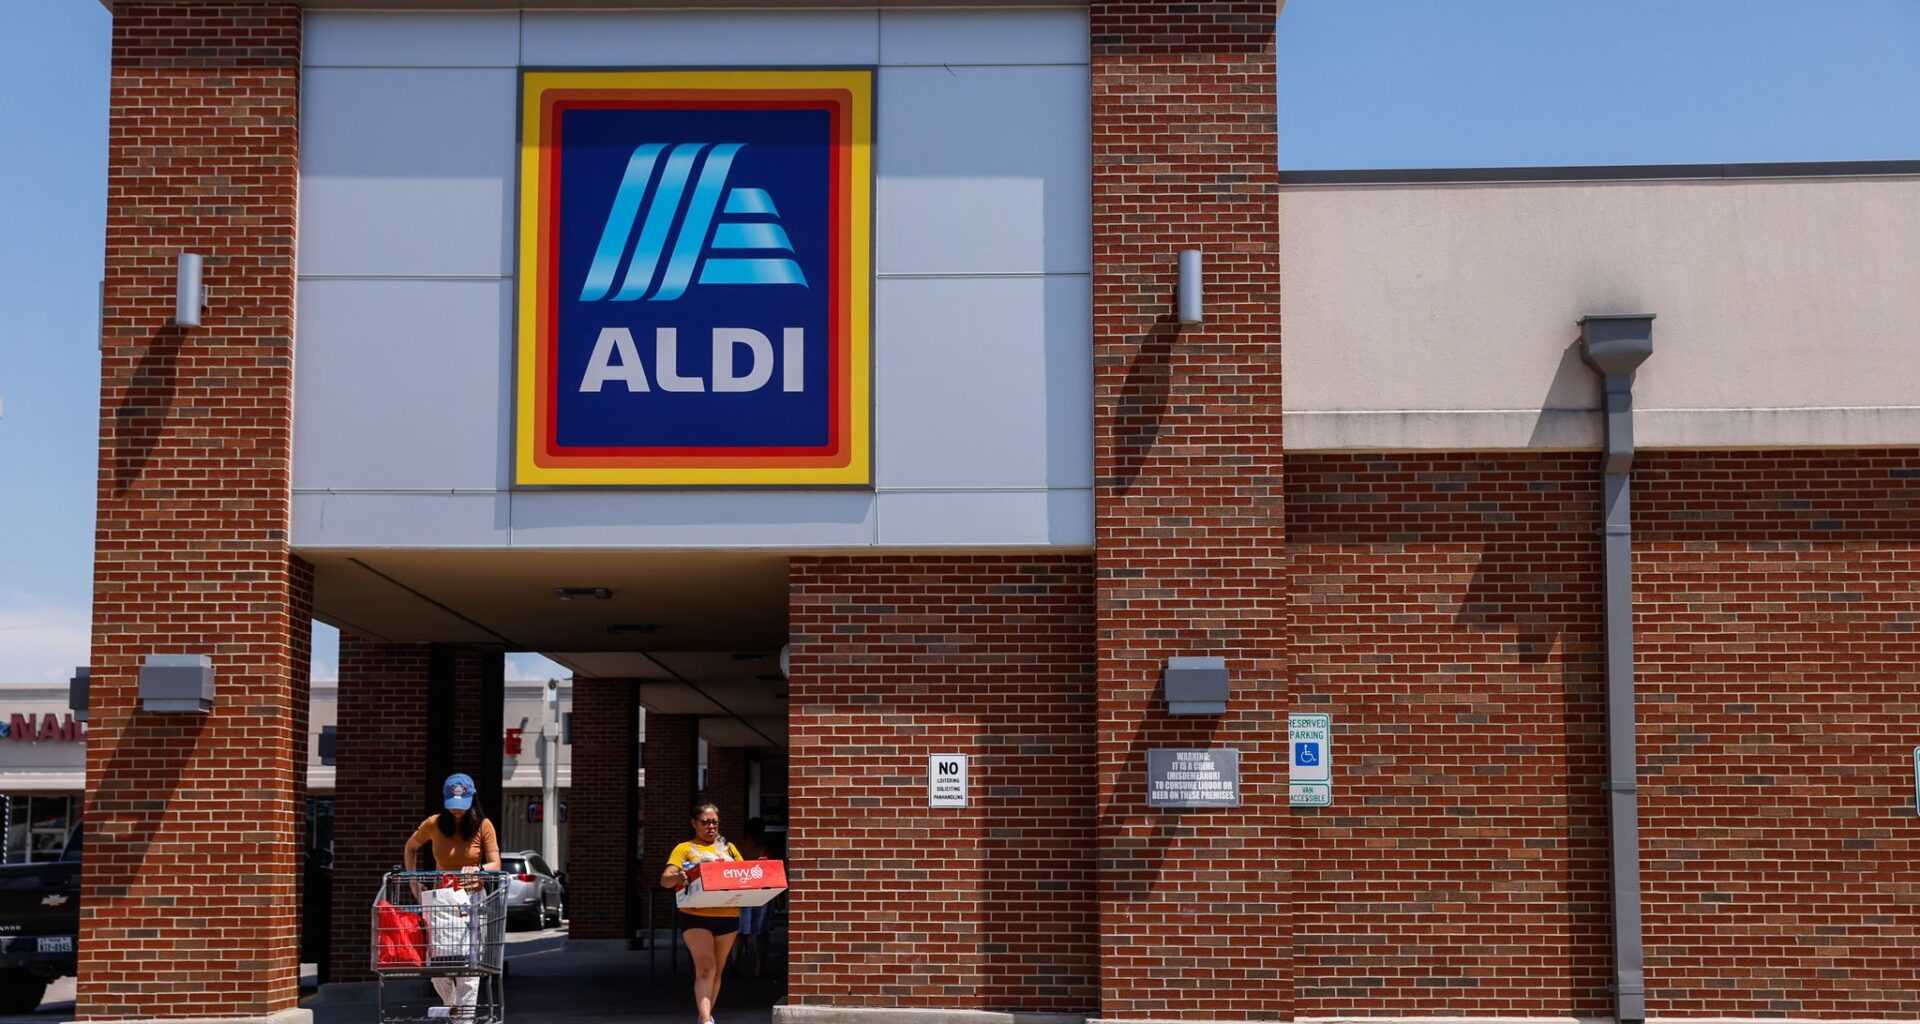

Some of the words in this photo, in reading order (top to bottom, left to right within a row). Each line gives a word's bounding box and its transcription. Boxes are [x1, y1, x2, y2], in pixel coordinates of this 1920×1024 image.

[579, 327, 804, 392] ALDI
[1288, 719, 1327, 728] RESERVED
[1290, 731, 1324, 739] PARKING
[1176, 752, 1210, 761] WARNING:
[938, 762, 959, 775] NO
[1172, 761, 1179, 771] IT
[1180, 761, 1187, 771] IS
[1187, 761, 1193, 771] A
[1193, 761, 1215, 771] CRIME
[1167, 771, 1220, 780] (MISDEMEANOR)
[1155, 781, 1164, 790] TO
[1165, 781, 1197, 790] CONSUME
[1198, 781, 1222, 790] LIQUOR
[1222, 781, 1233, 790] OR
[1152, 791, 1169, 800] BEER
[1169, 791, 1179, 800] ON
[1180, 791, 1200, 800] THESE
[1200, 791, 1236, 800] PREMISES.
[723, 868, 752, 884] envy
